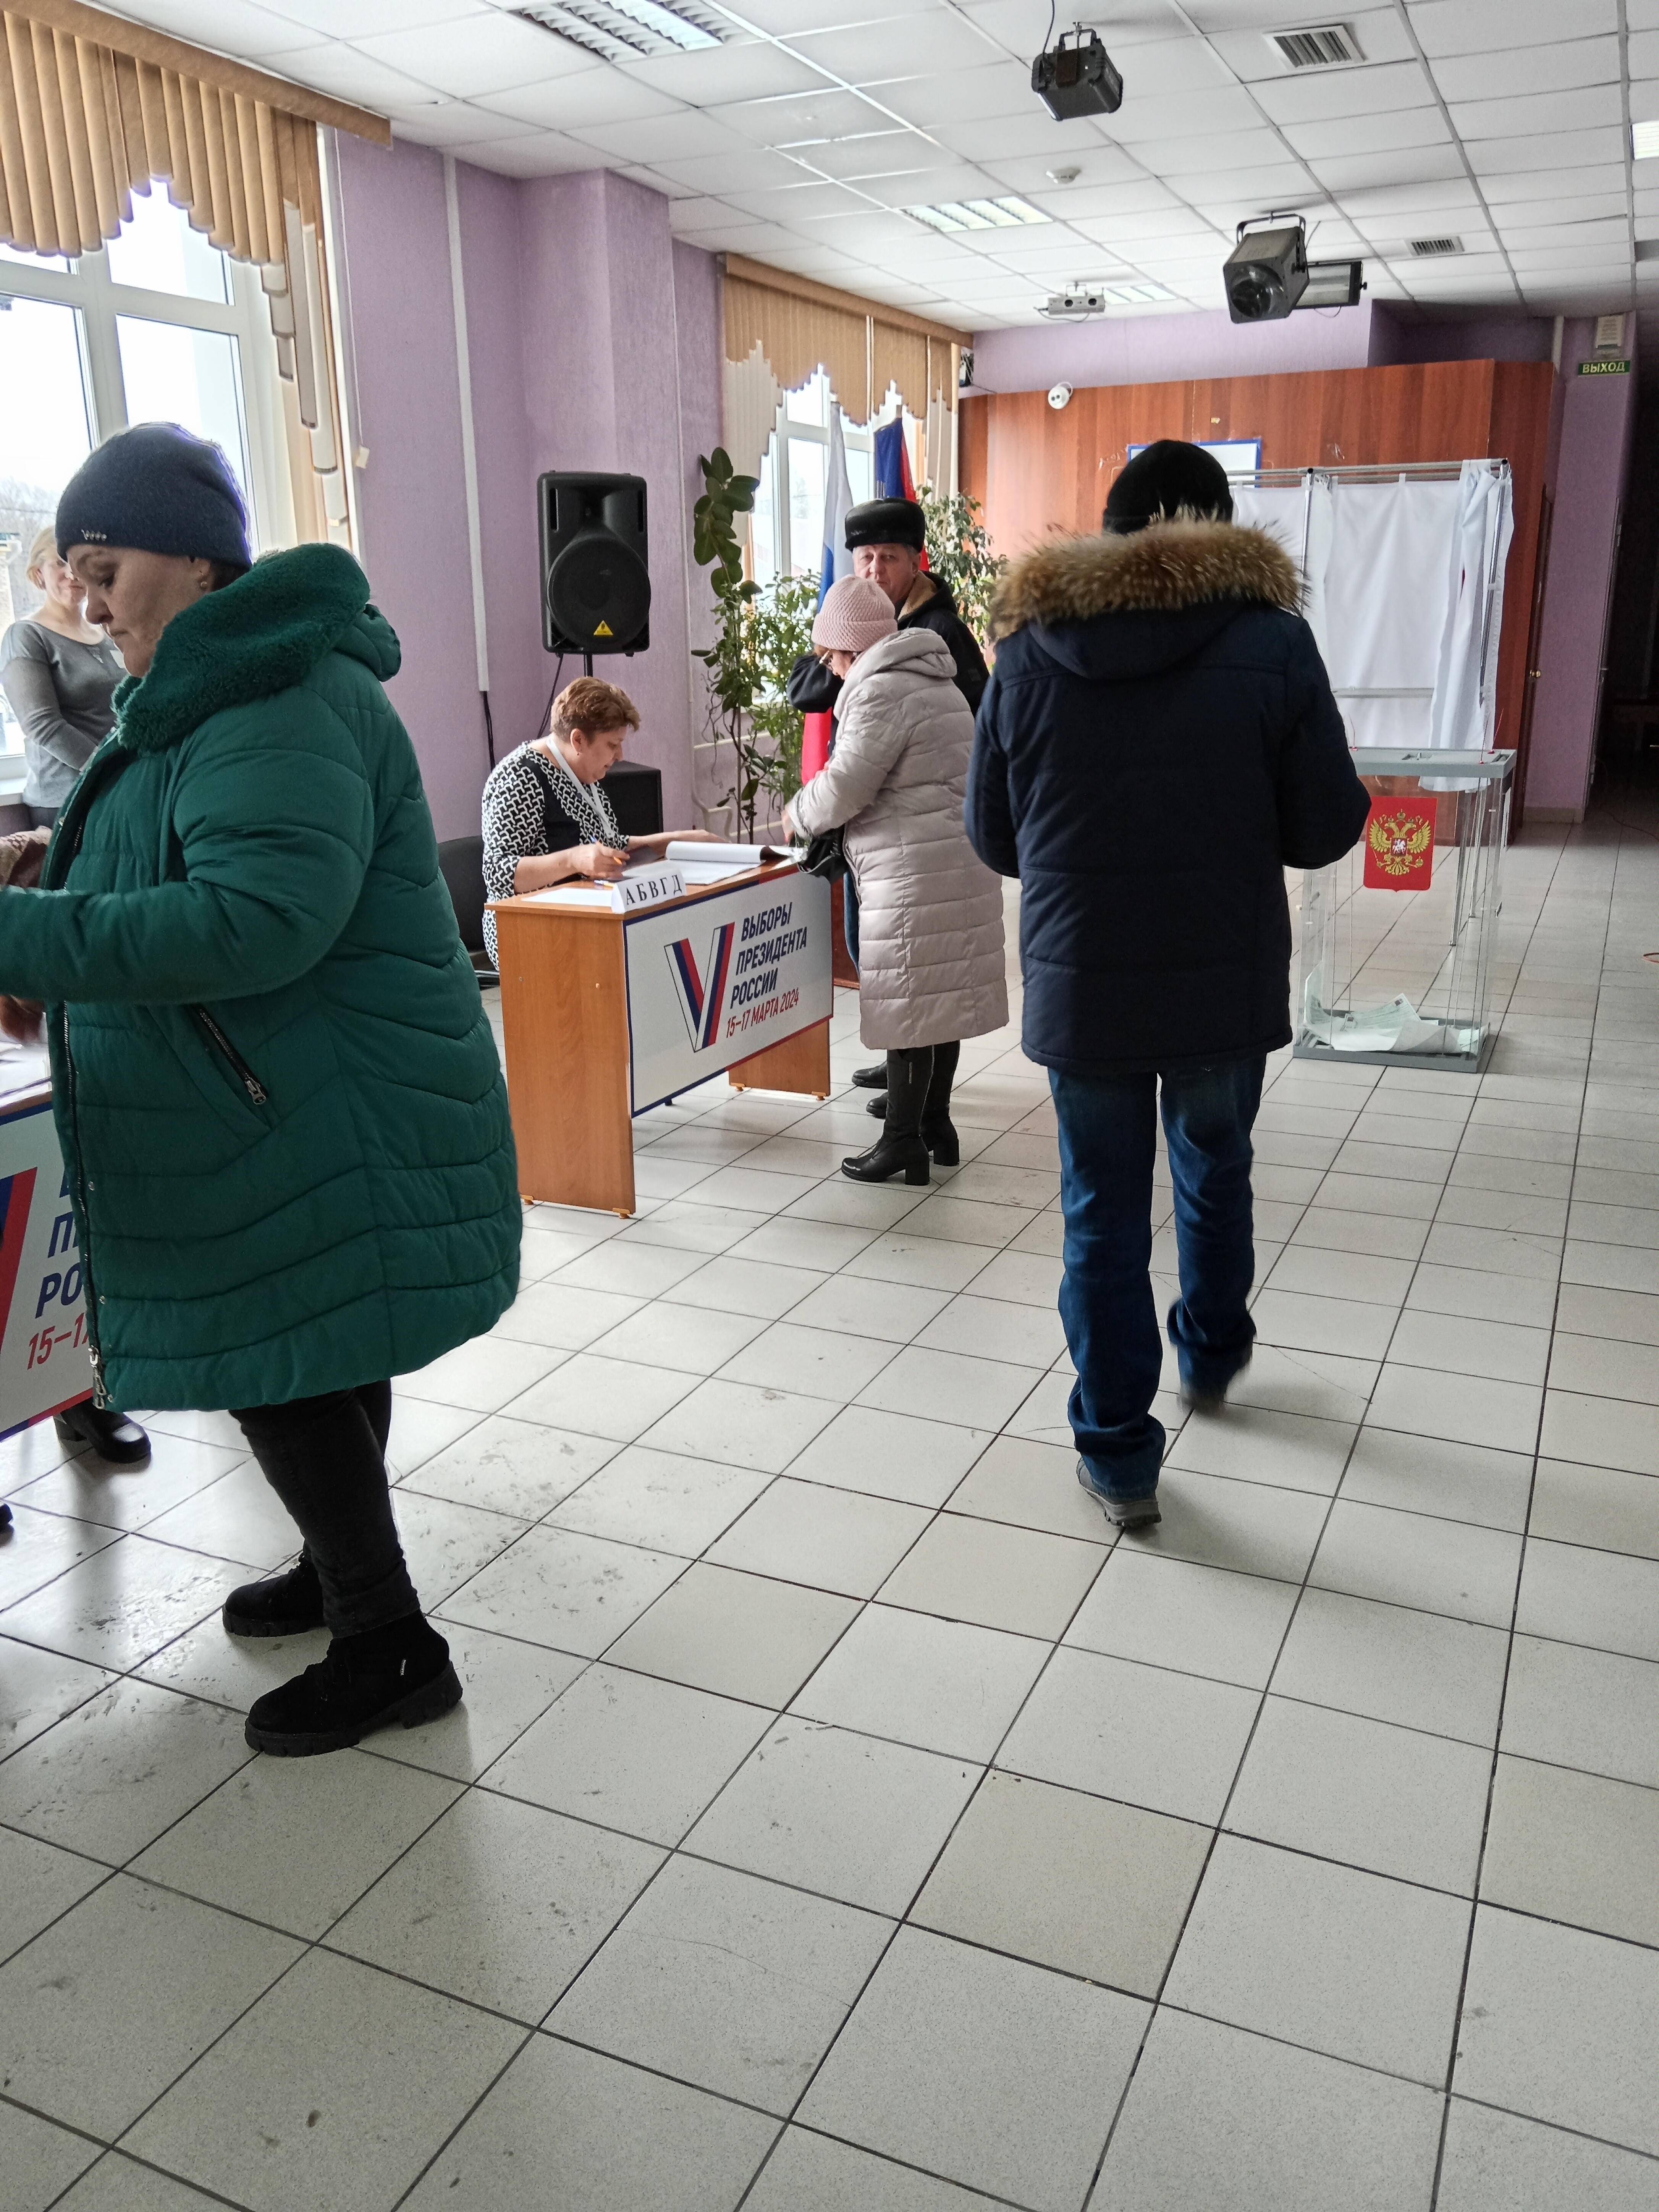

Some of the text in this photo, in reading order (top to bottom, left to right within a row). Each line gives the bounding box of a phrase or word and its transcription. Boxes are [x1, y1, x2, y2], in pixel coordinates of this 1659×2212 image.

[1583, 362, 1625, 373] ВЫХОД
[741, 902, 792, 942] ВЫБОРЫ
[736, 927, 807, 976] ПРЕЗИДЕНТА
[730, 968, 778, 1009] РОССИИ
[751, 996, 779, 1027] МАРТА
[779, 987, 799, 1013] 2024
